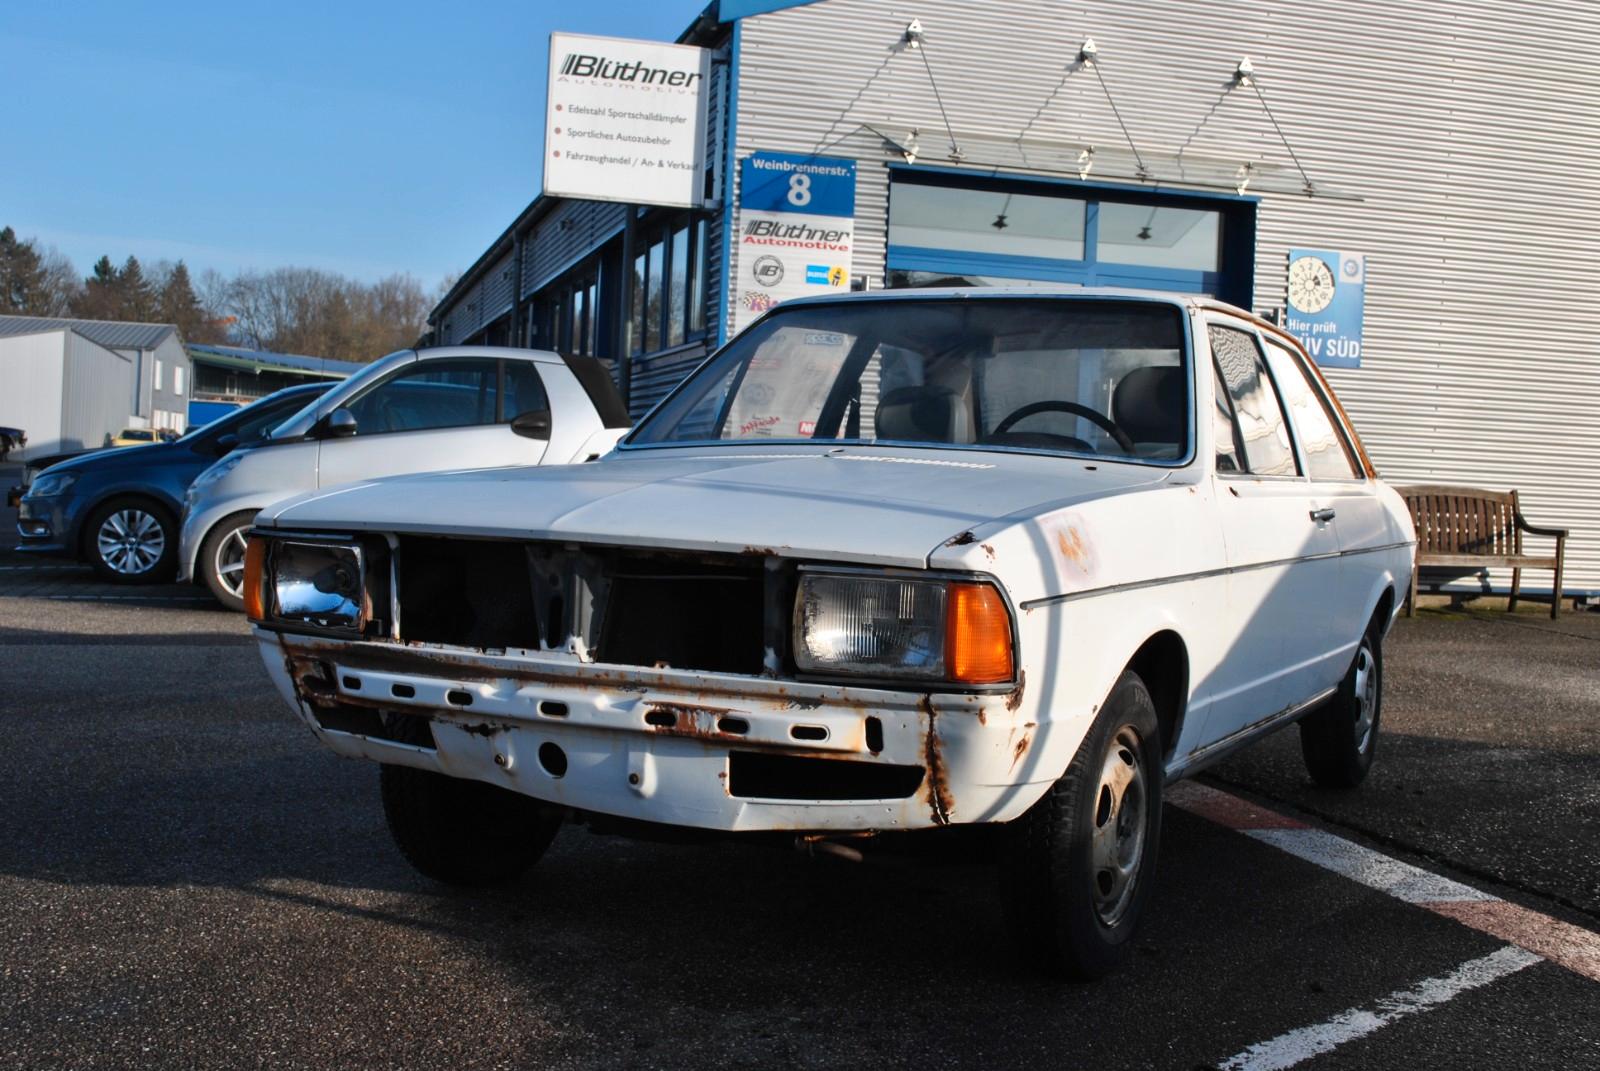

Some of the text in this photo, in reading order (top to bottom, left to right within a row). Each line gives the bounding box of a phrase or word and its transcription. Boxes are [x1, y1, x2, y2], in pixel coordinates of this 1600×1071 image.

[570, 55, 703, 88] Blüthner
[557, 75, 700, 97] Automotive
[568, 105, 687, 125] Edelstahl Sportschalldämpfer
[567, 128, 672, 145] Sportliches Autozubehör
[566, 151, 631, 165] Fahrzeughandel
[657, 159, 664, 168] &
[667, 160, 699, 172] Verkauf
[752, 158, 850, 177] Weinbrennerstr.
[787, 173, 811, 206] 8
[743, 236, 848, 252] Automotive
[1289, 319, 1337, 335] Hier prüft
[1300, 333, 1359, 358] ÜV SÜD
